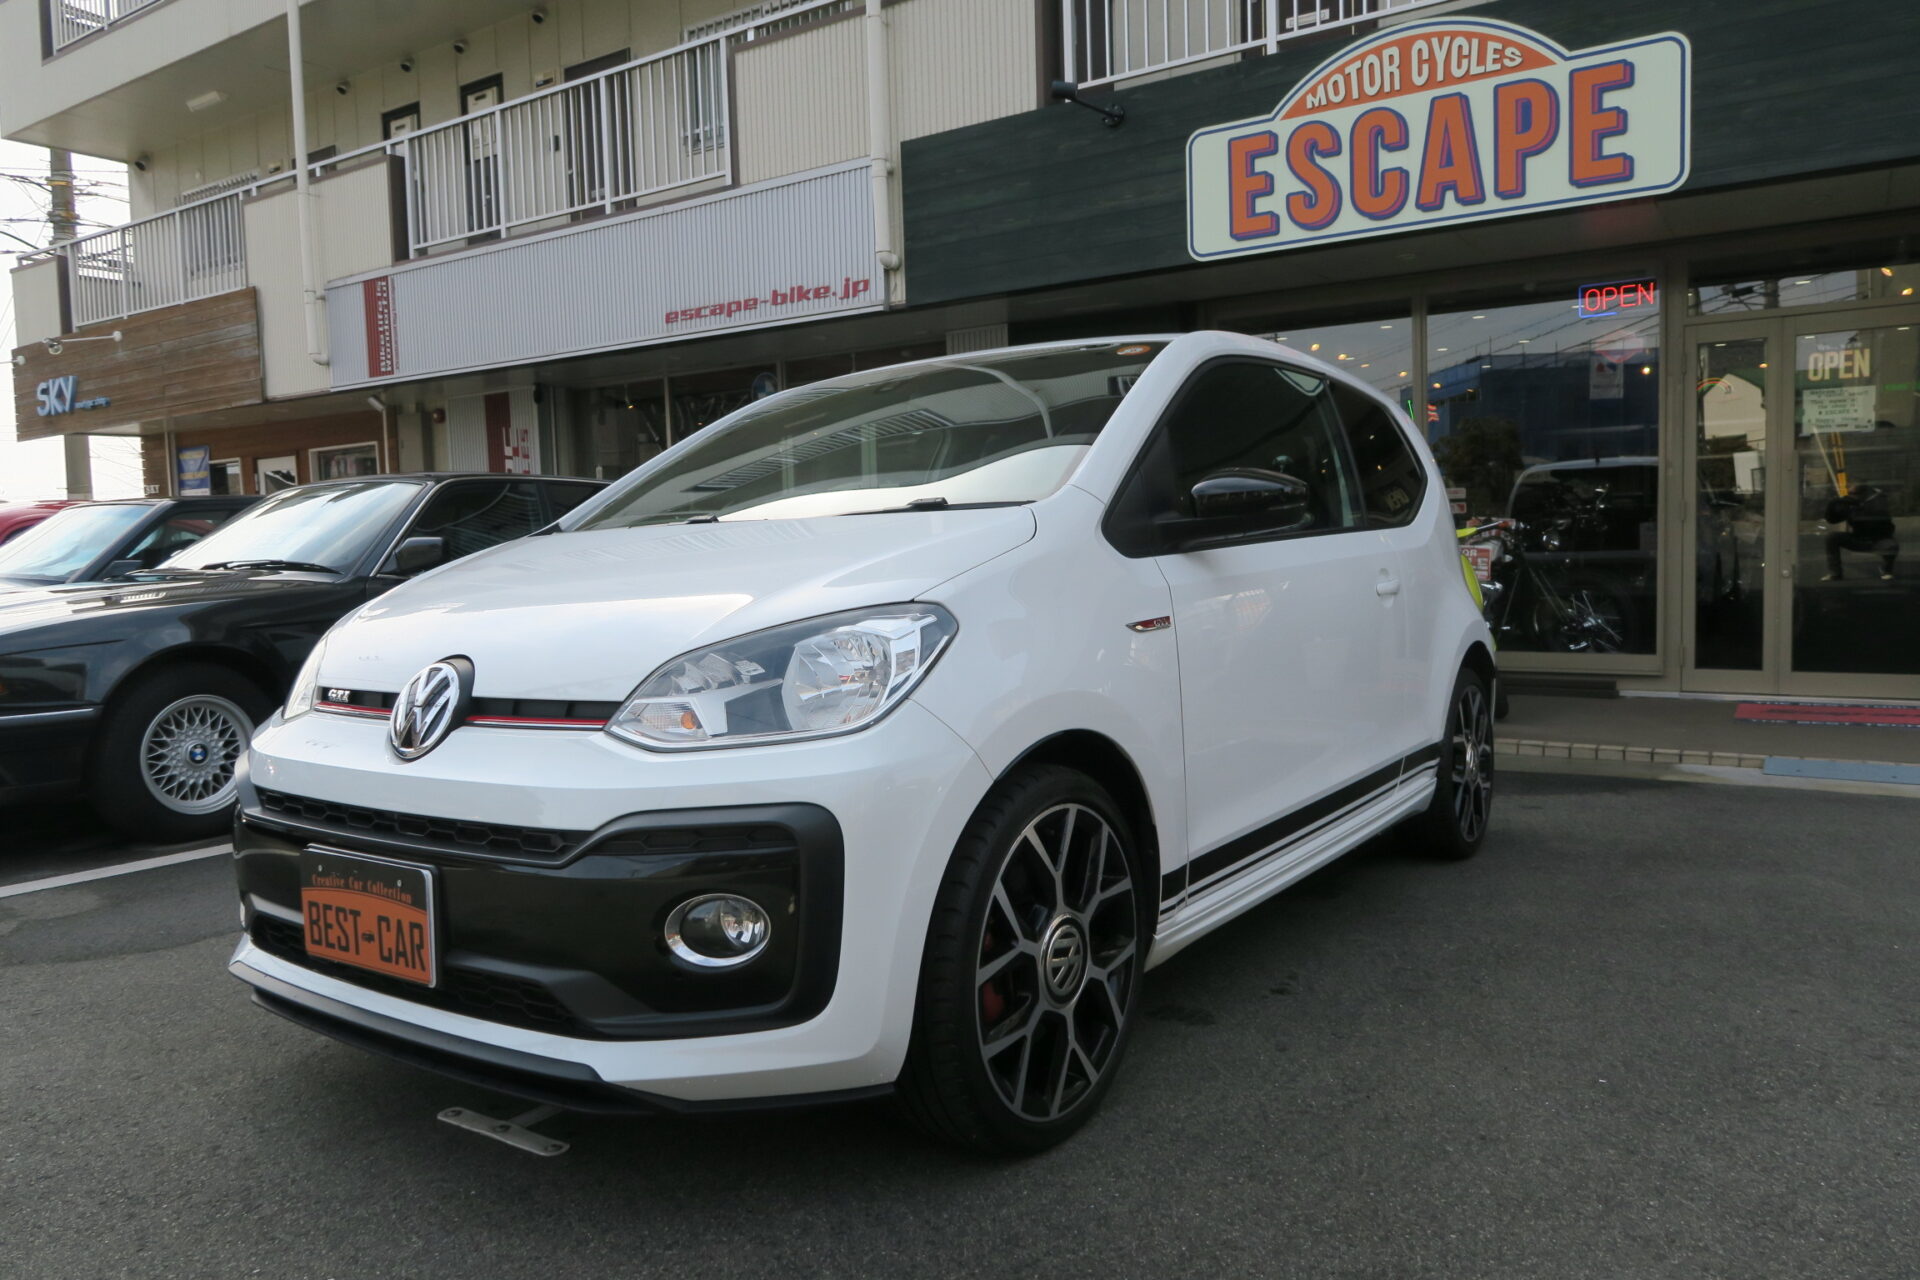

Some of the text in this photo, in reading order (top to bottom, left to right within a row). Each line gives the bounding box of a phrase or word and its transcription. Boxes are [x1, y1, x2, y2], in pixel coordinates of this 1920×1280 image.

[1306, 35, 1524, 109] MOTOR CYCLES
[1228, 59, 1635, 242] ESCAPE
[665, 277, 870, 324] escape-bike.jp
[1584, 282, 1655, 312] OPEN
[1807, 348, 1871, 382] OPEN
[36, 375, 78, 416] SKY
[327, 688, 351, 702] GTI
[312, 873, 413, 905] Creative Car Collection
